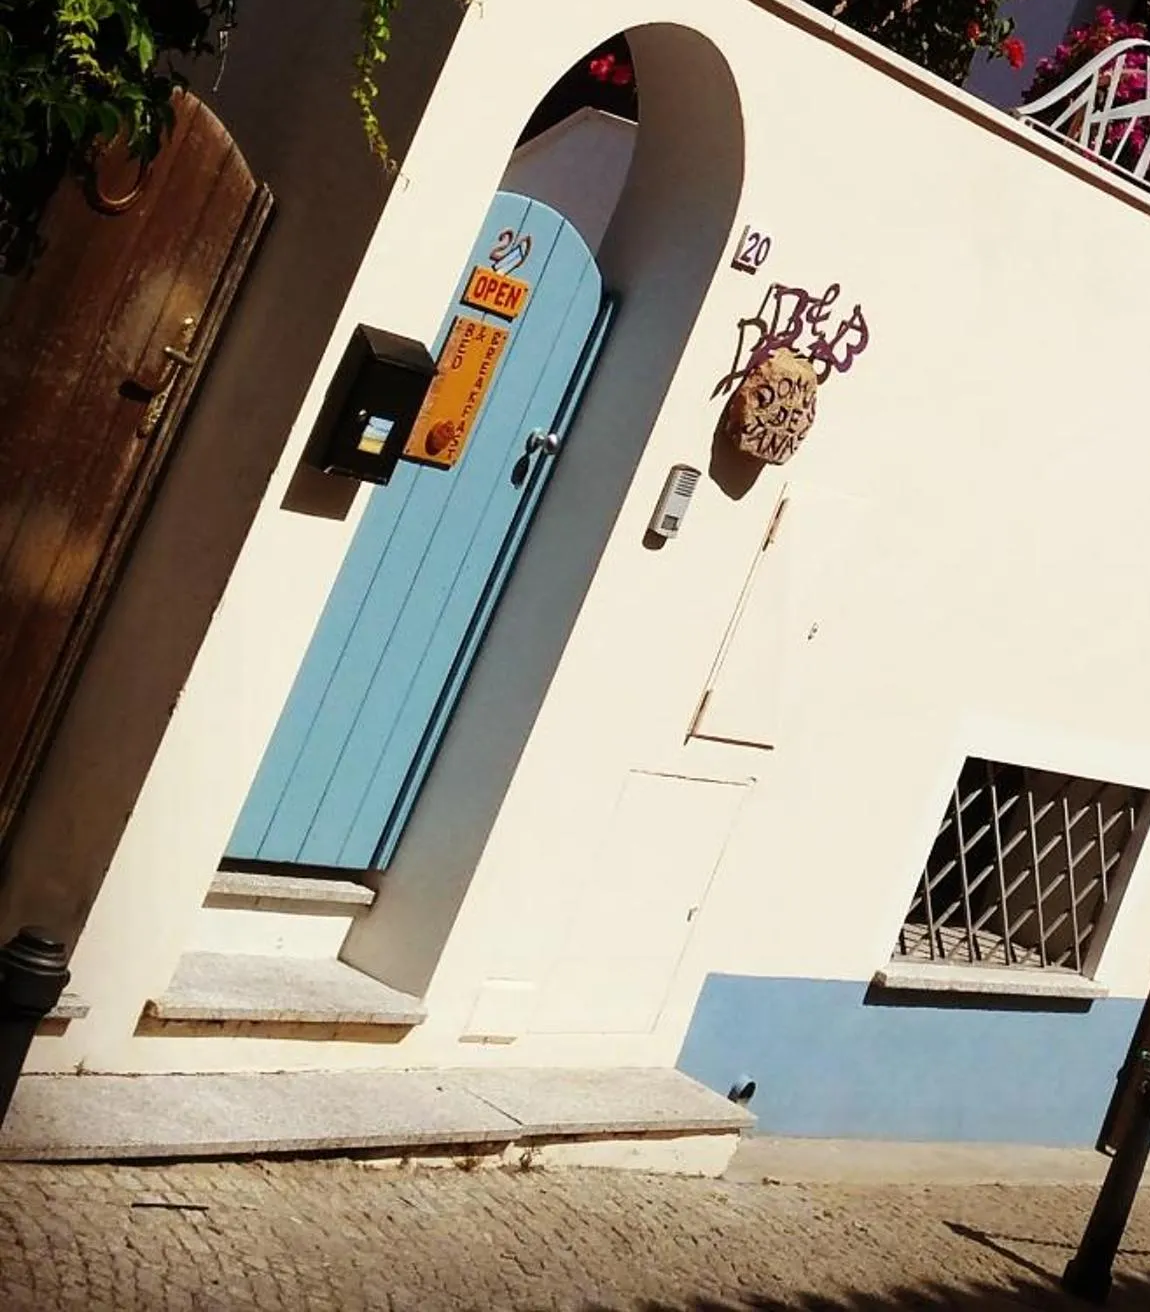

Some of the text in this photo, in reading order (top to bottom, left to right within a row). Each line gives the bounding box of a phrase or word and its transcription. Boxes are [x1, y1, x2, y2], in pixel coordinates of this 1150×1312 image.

[741, 232, 771, 266] 20
[474, 274, 522, 310] OPEN
[452, 323, 475, 370] BED
